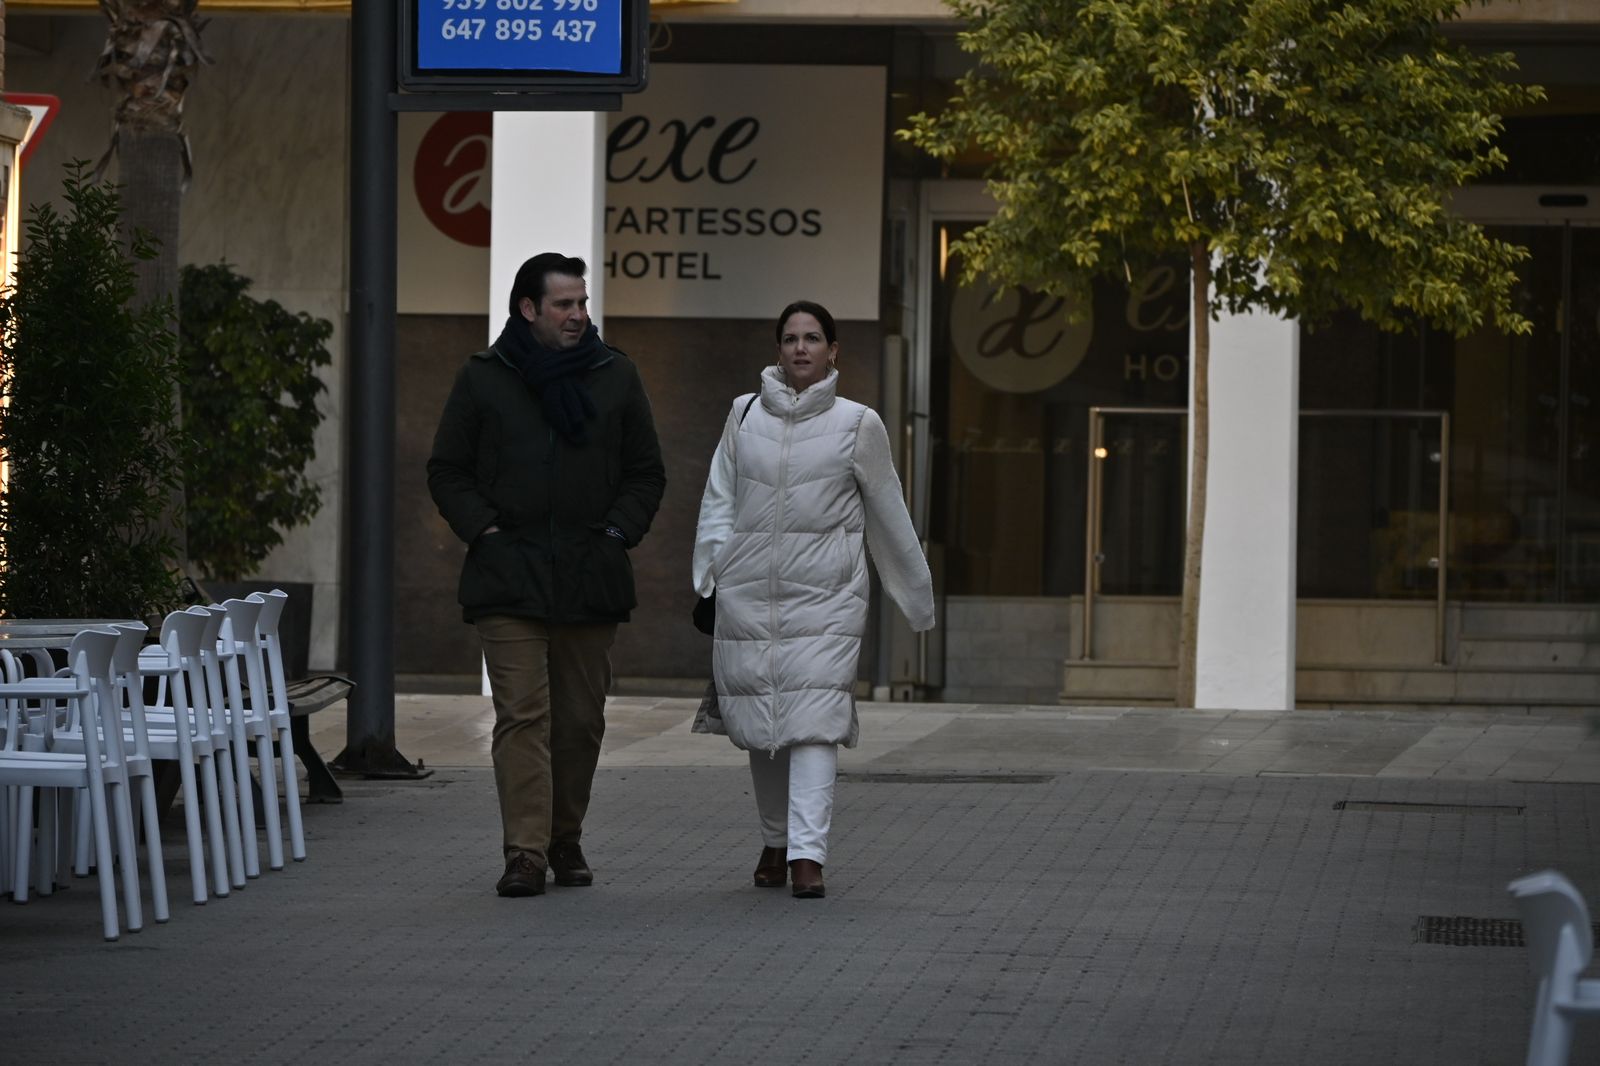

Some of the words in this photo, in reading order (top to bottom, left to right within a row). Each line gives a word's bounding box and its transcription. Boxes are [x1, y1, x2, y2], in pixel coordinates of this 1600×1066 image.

[441, 18, 486, 41] 647
[495, 18, 543, 42] 895
[551, 19, 597, 43] 437
[606, 115, 760, 185] exe
[605, 206, 822, 237] TARTESSOS
[1126, 265, 1189, 331] e
[1124, 353, 1189, 381] HO
